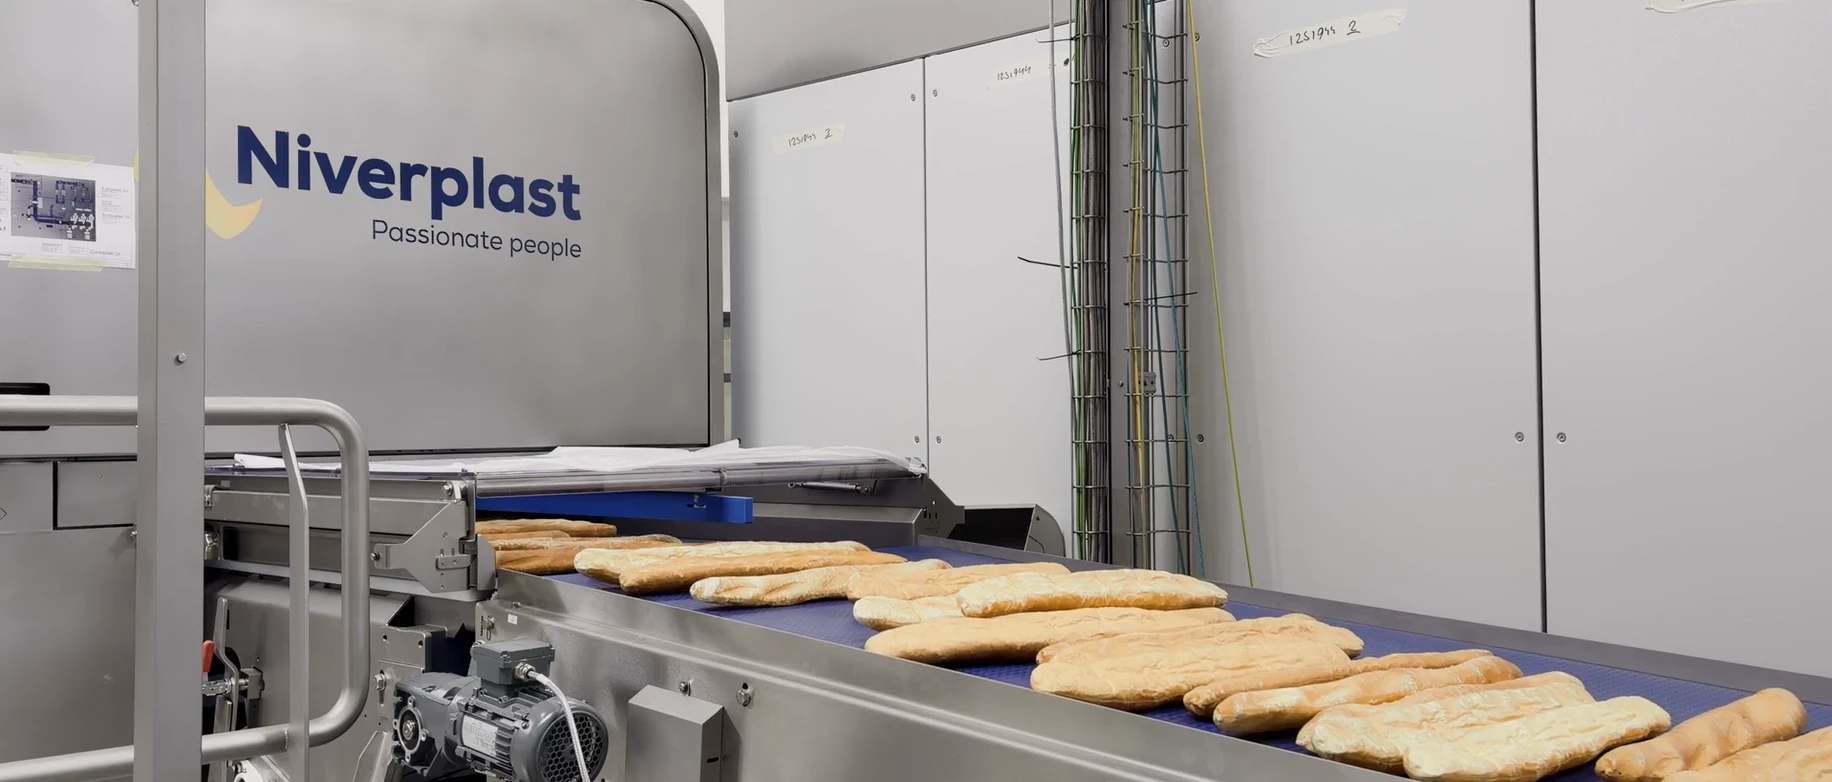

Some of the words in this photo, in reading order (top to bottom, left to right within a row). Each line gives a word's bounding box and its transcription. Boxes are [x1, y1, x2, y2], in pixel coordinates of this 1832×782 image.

[1289, 26, 1336, 46] 1251944
[1346, 20, 1361, 35] 2
[237, 125, 582, 221] Niverplast
[372, 219, 503, 250] Passionate
[510, 237, 582, 261] people
